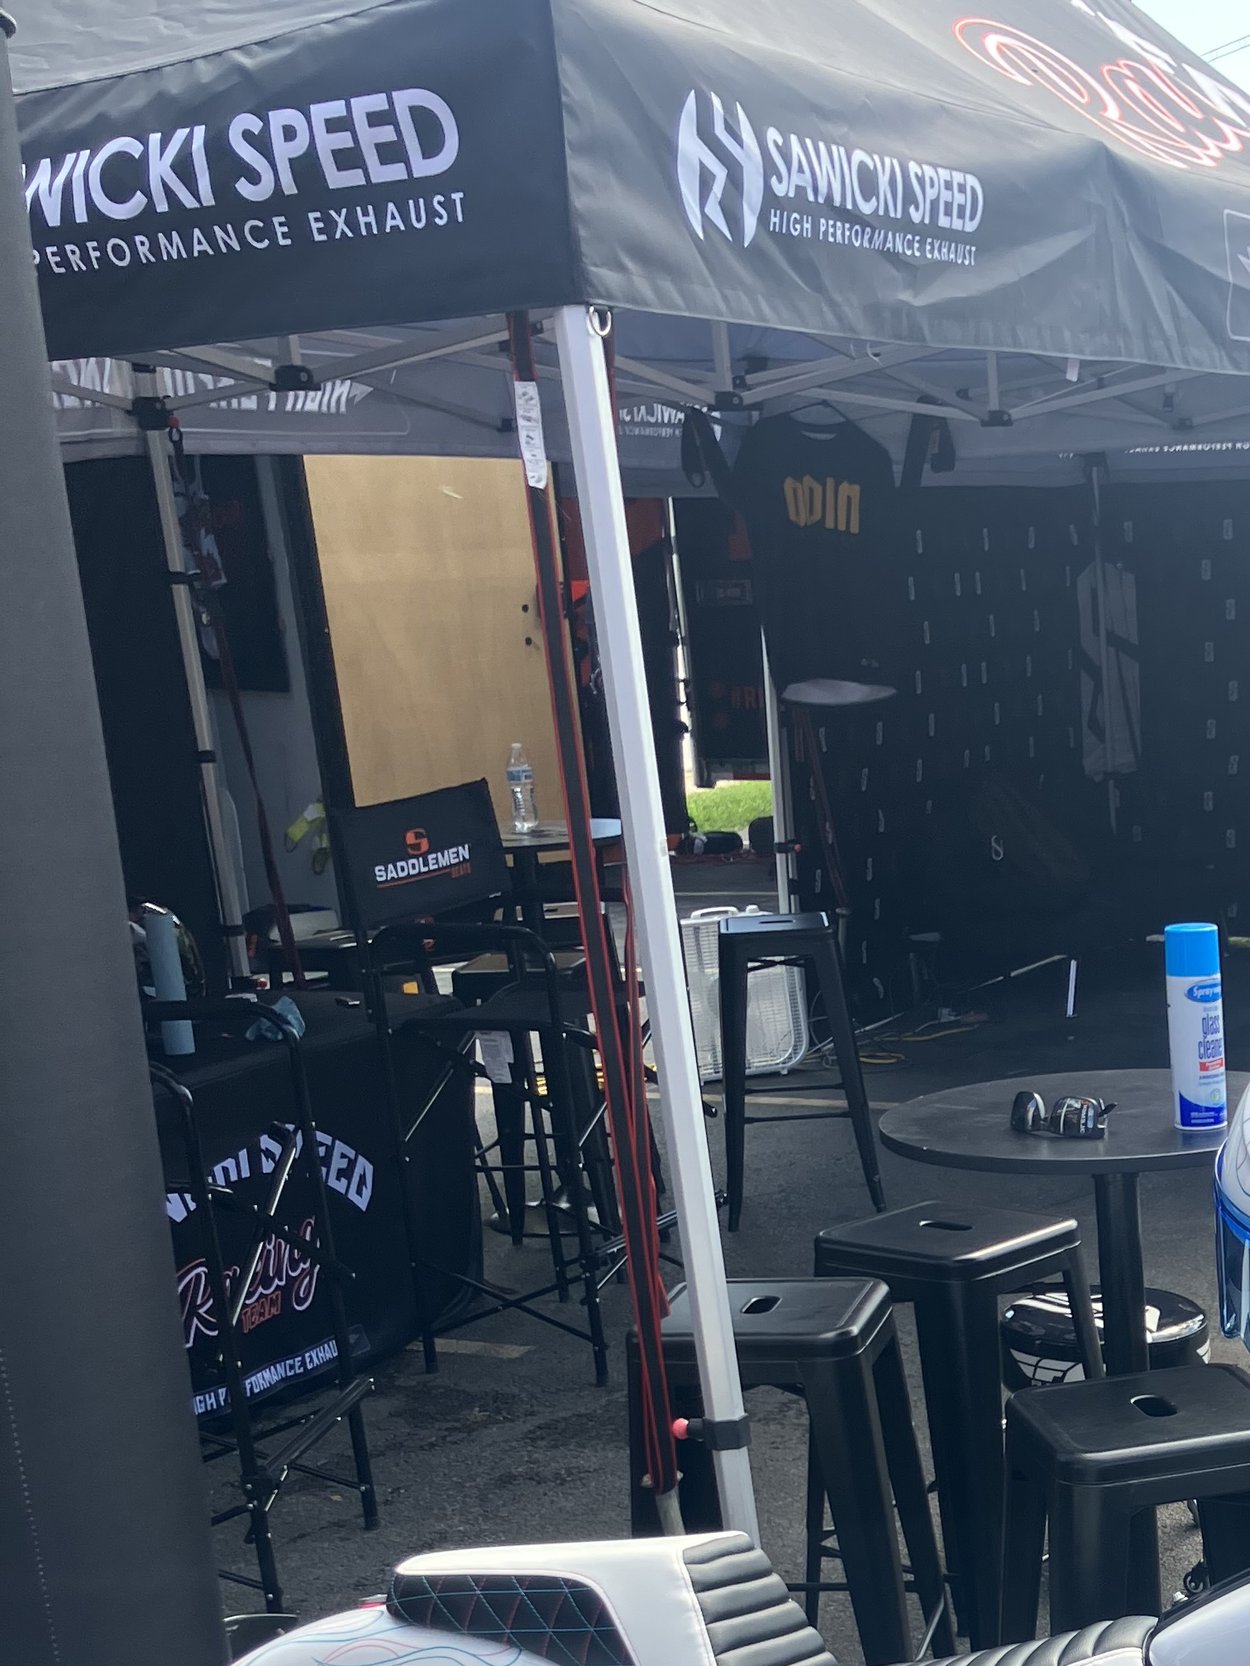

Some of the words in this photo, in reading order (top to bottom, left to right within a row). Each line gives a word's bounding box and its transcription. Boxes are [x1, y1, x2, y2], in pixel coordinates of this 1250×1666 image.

[228, 88, 459, 203] SPEED
[766, 126, 903, 219] SAWICKI
[908, 160, 984, 233] SPEED
[308, 191, 465, 242] EXHAUST
[769, 208, 812, 239] HIGH
[819, 217, 921, 257] PERFORMANCE
[925, 237, 977, 267] EXHAUST
[374, 843, 470, 882] SADDLEMEN
[304, 1339, 340, 1369] EXHAU
